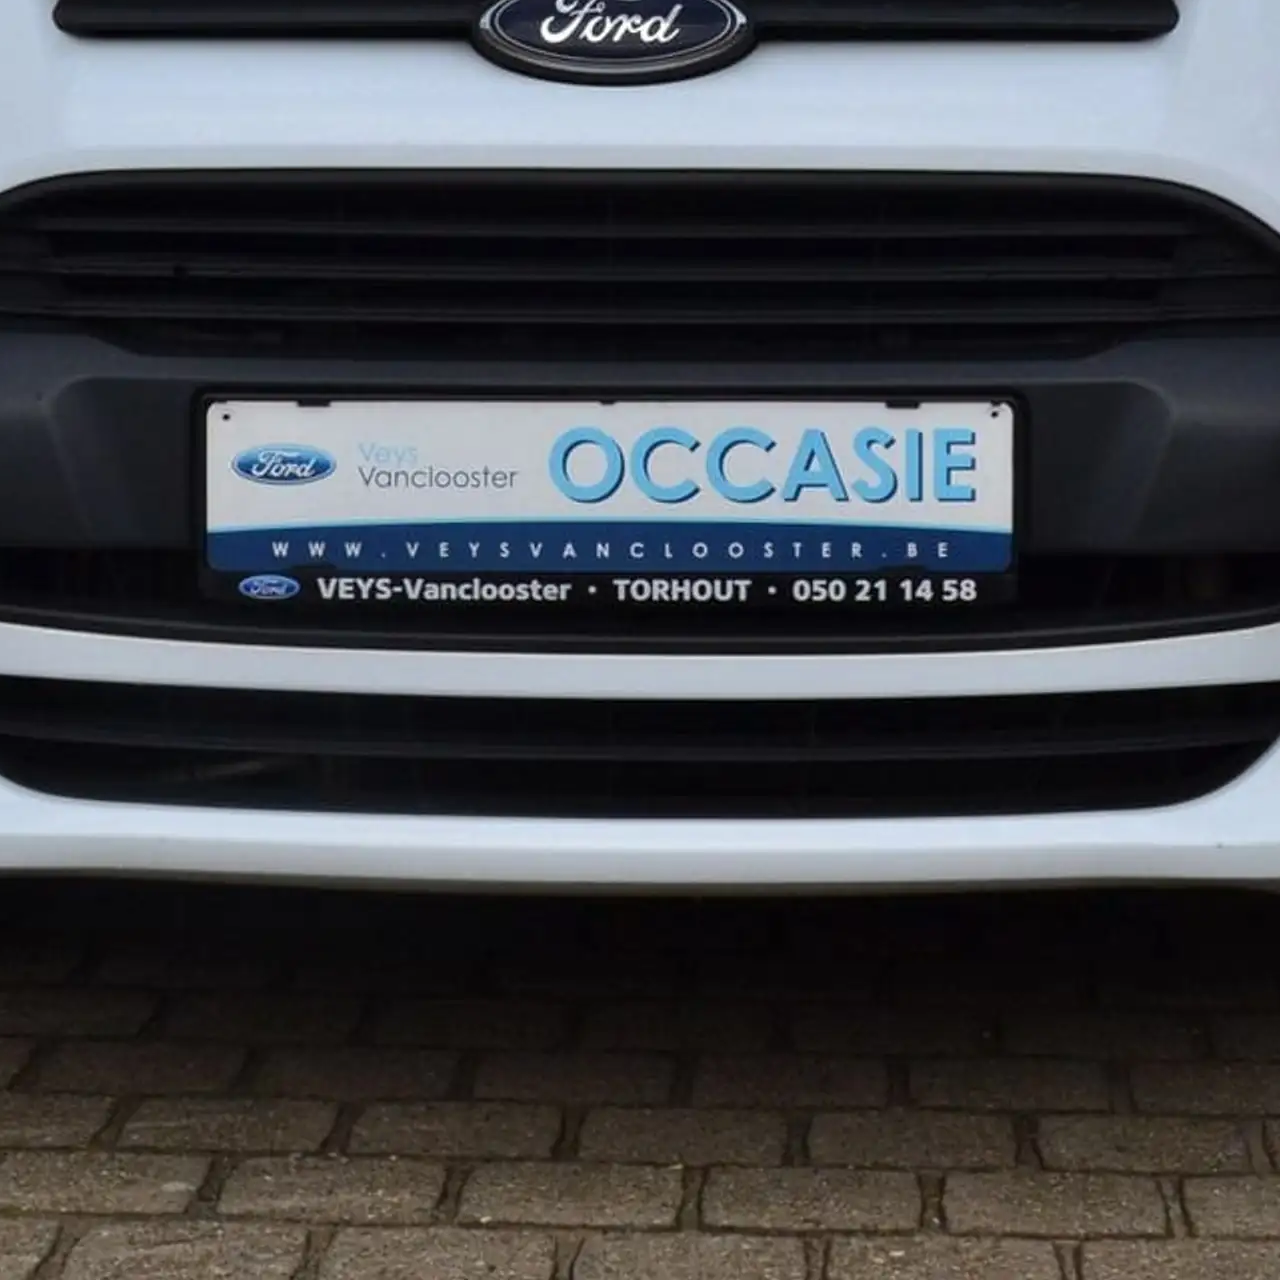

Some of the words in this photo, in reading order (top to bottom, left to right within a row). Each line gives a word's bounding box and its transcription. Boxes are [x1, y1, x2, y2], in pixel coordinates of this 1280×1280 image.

[252, 450, 316, 477] Ford
[359, 442, 418, 465] Veys
[548, 426, 977, 504] OCCASIE
[358, 467, 520, 488] Vanclooster
[272, 541, 949, 559] WWW.VEYSVANCLOOSTER.BE
[317, 577, 572, 601] VEYS-Vanclooster
[613, 579, 753, 601] TORHOUT
[792, 579, 847, 601] 050
[854, 579, 887, 601] 21
[900, 579, 934, 601] 14
[941, 579, 977, 602] 58
